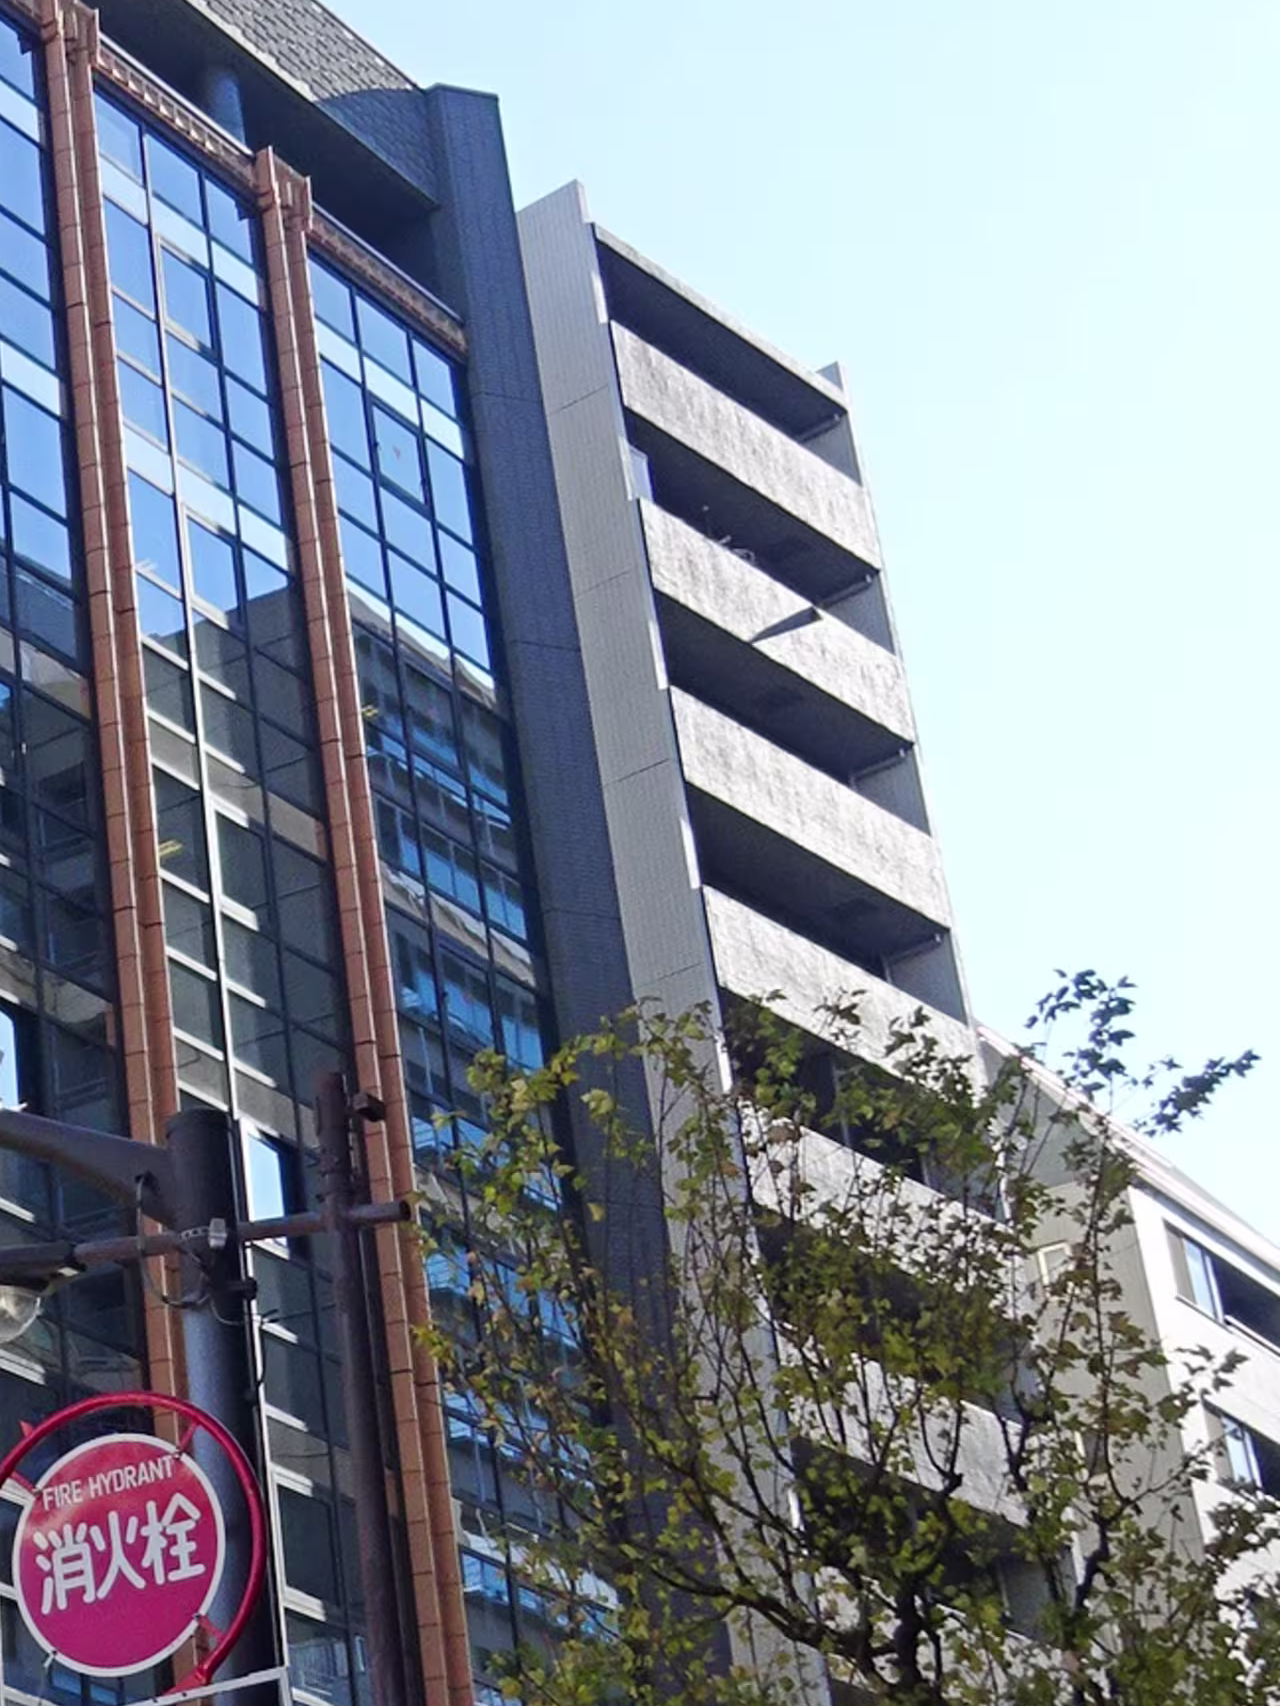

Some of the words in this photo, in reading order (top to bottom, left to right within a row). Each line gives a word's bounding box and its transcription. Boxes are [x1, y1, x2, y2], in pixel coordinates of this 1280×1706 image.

[42, 1480, 83, 1511] FIRE
[88, 1454, 173, 1499] HYDRANT
[33, 1492, 206, 1615] 消火栓
